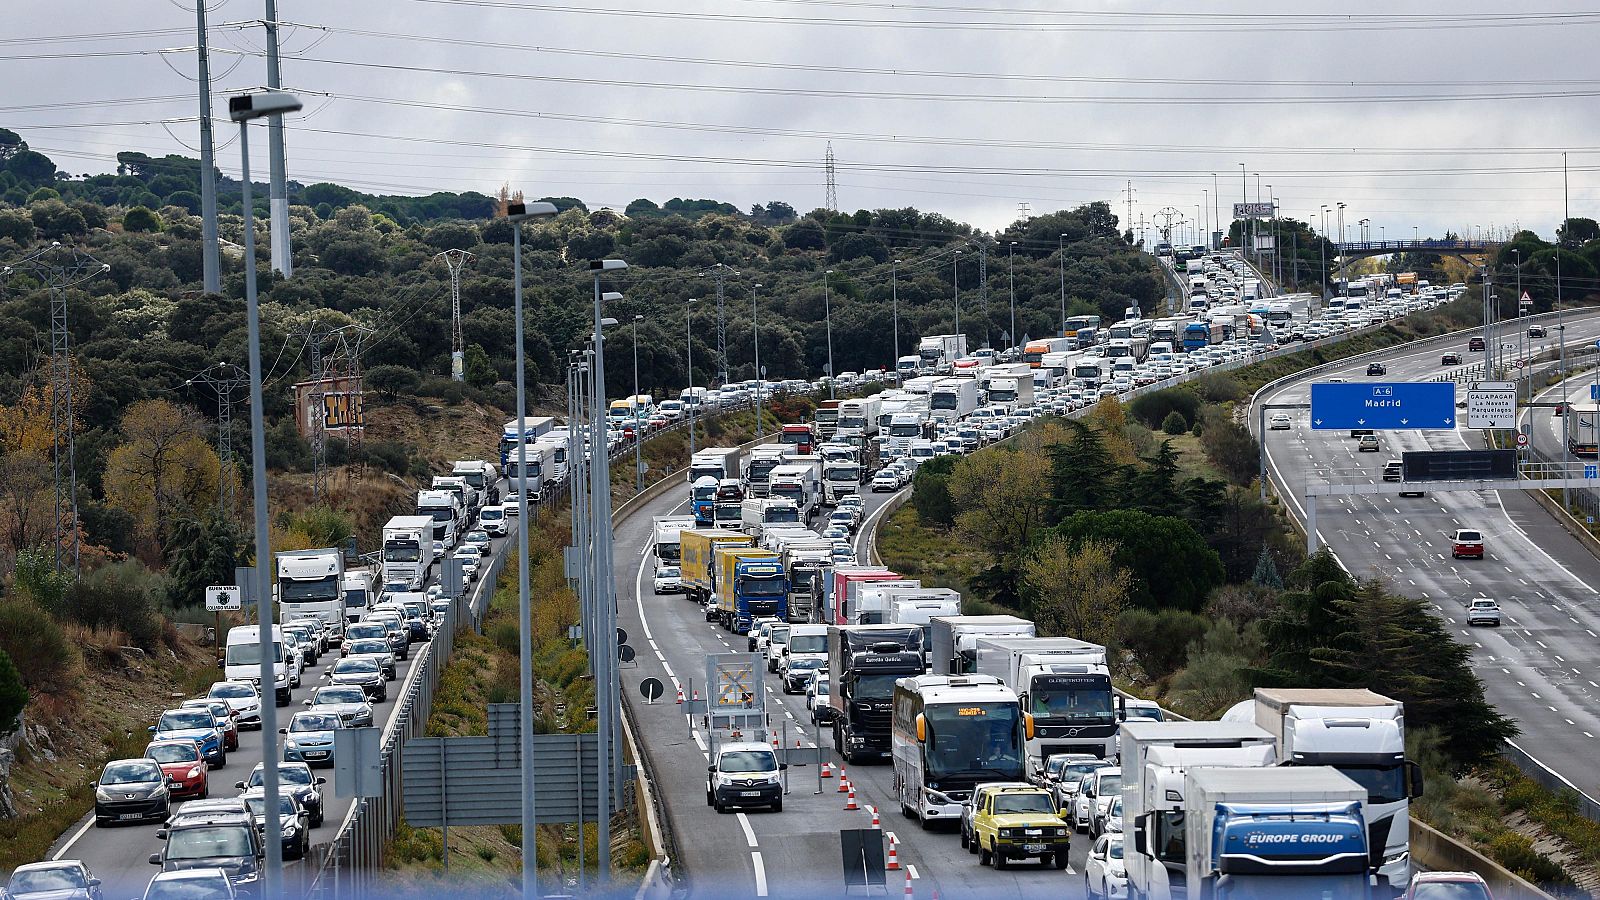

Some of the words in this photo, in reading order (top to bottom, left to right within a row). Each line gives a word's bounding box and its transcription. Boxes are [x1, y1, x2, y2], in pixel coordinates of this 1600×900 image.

[1365, 399, 1401, 407] Madrid
[1248, 834, 1299, 843] EUROPE
[1300, 834, 1344, 843] GROUP
